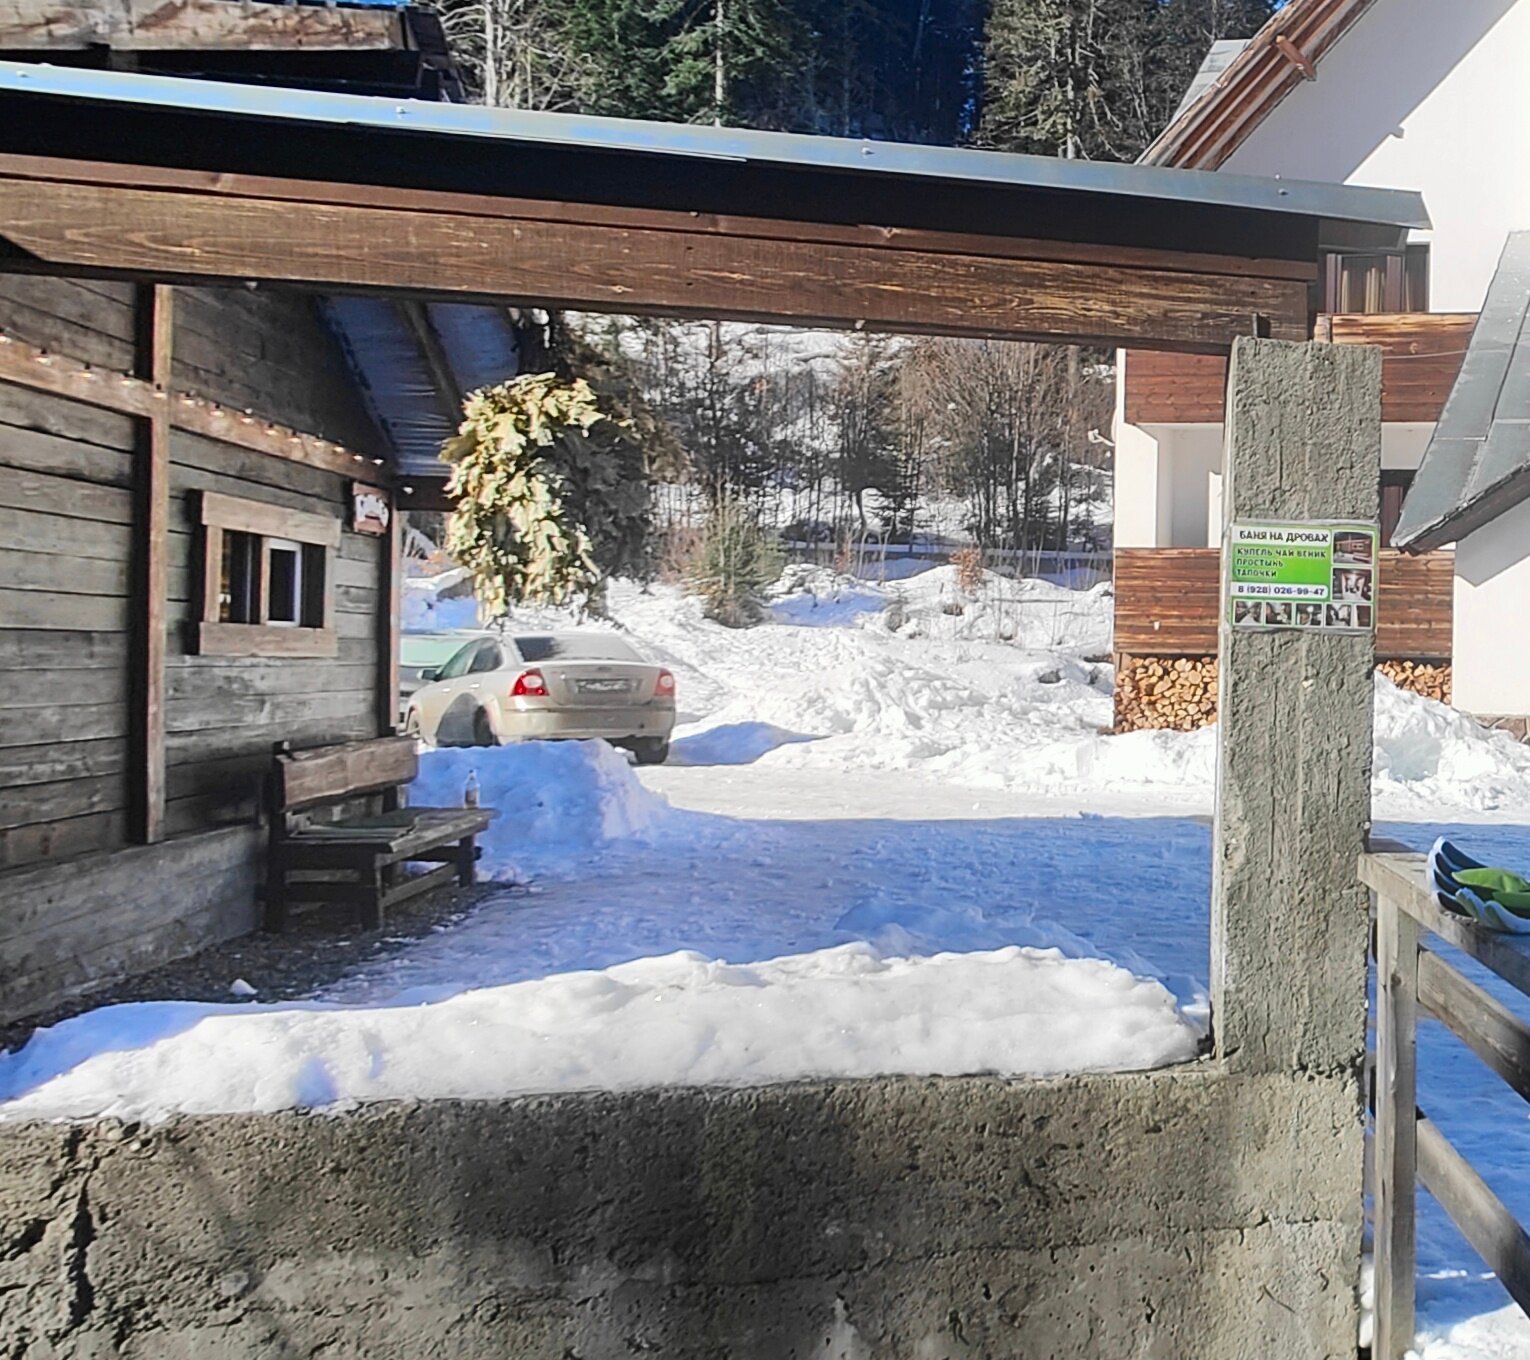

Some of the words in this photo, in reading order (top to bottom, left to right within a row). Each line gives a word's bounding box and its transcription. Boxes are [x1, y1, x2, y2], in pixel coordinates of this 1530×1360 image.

[1239, 530, 1267, 540] БАНЯ
[1269, 531, 1284, 541] НА
[1285, 532, 1329, 543] ДРОВАХ
[1237, 547, 1273, 556] КУПЕЛЬ
[1296, 550, 1327, 558] ВЕНИК
[1236, 568, 1277, 577] ТАПОЧКИ
[1237, 585, 1244, 593] 8
[1246, 585, 1272, 594] (928)
